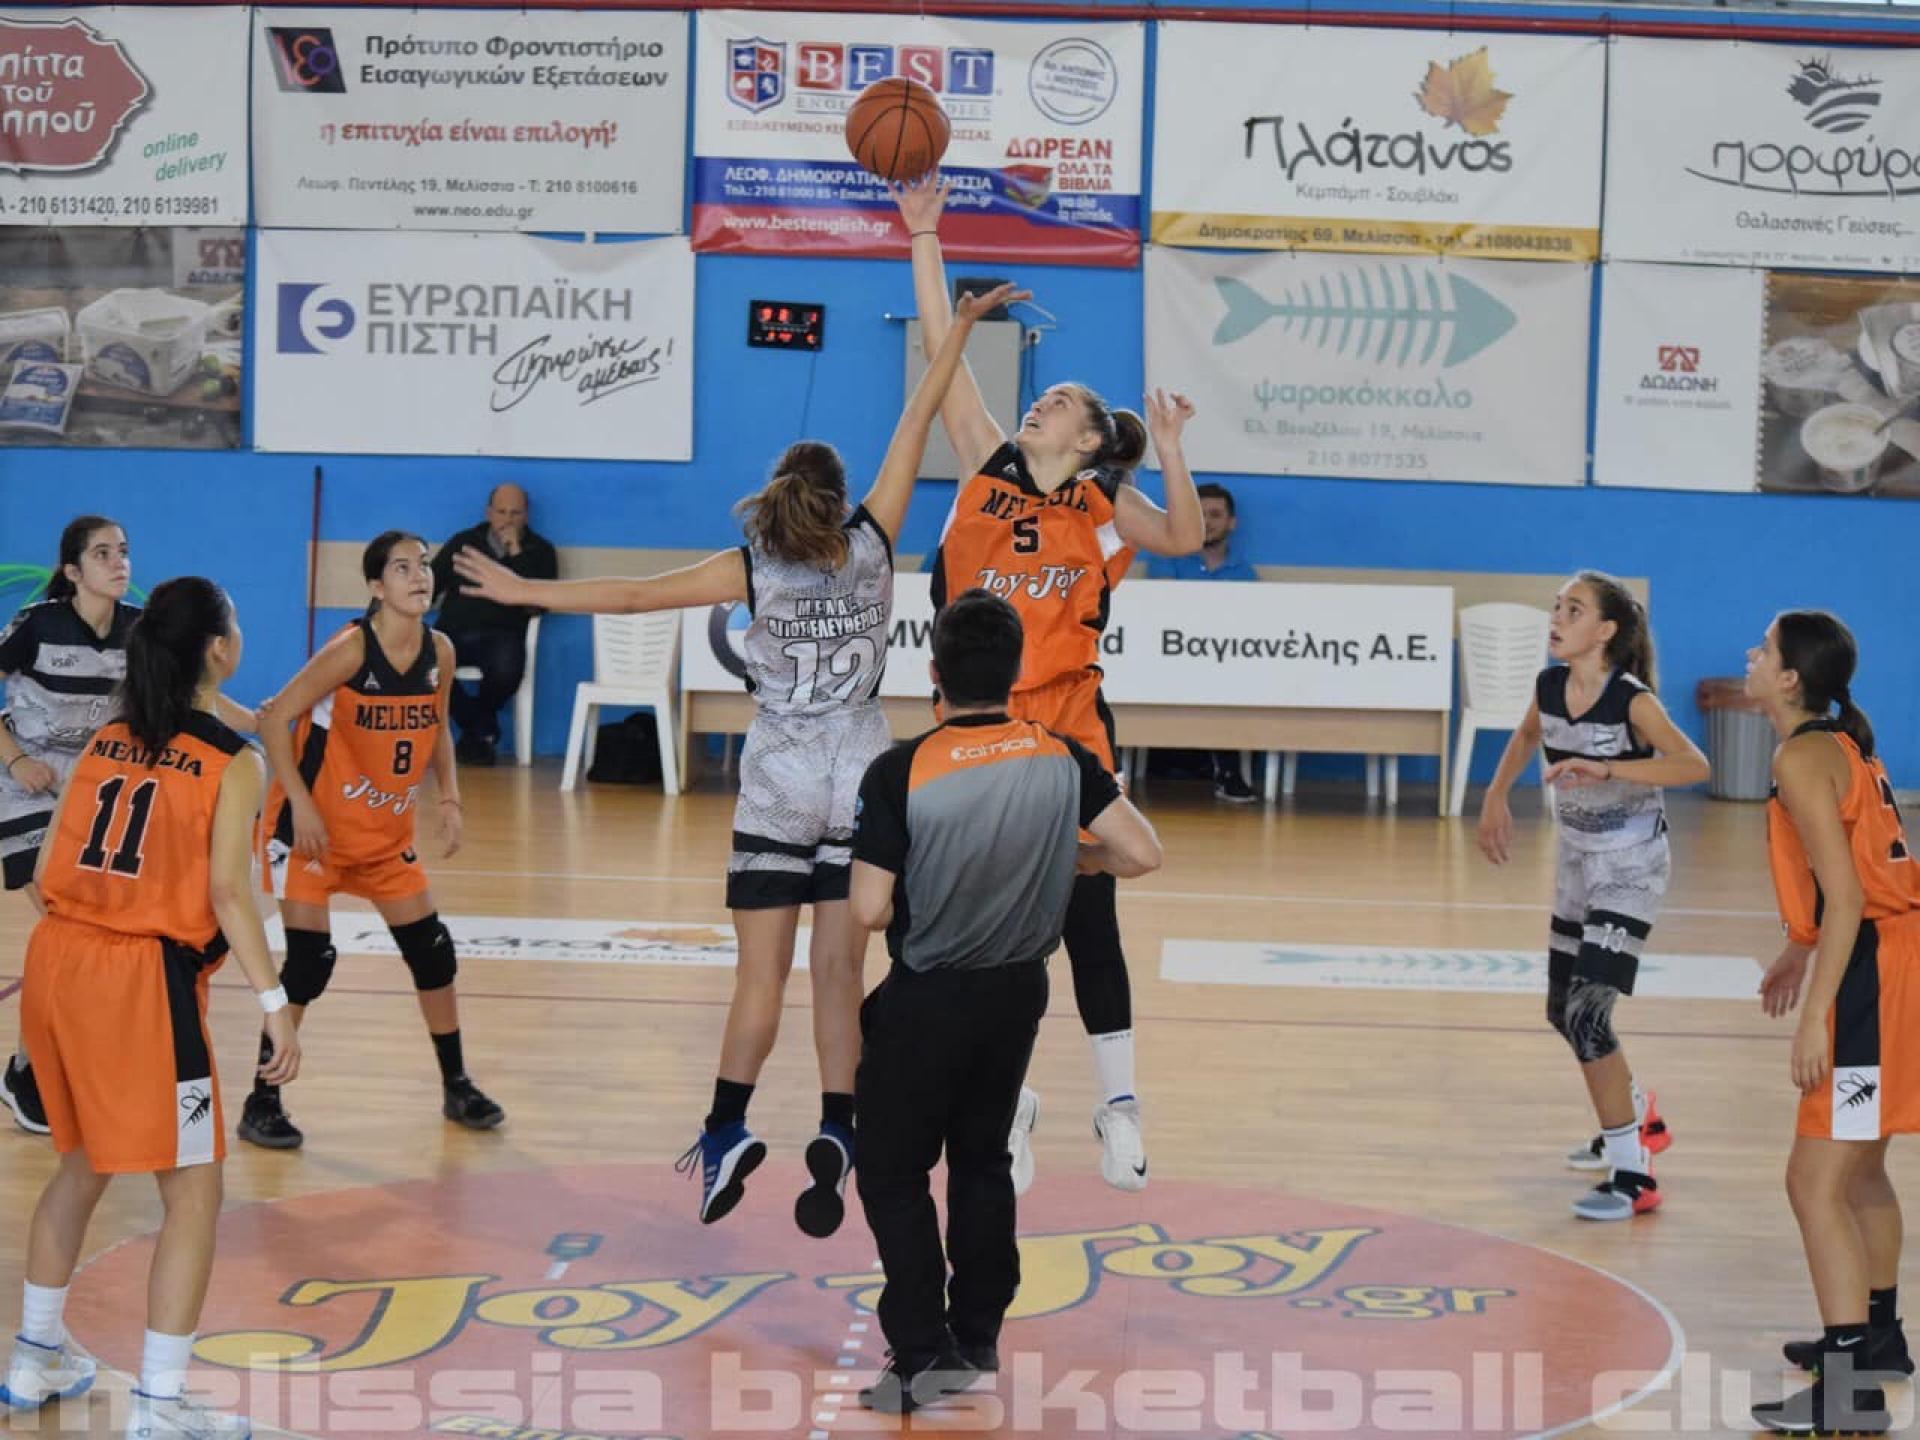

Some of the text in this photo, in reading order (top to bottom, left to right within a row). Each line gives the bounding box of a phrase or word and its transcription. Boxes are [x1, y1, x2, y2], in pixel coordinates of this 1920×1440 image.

[366, 34, 664, 62] Πρότυπο Φροντιστήριο
[360, 64, 668, 89] Εισαγωγικών Εξετάσεων
[802, 46, 990, 92] BEST
[143, 132, 199, 158] online
[342, 119, 443, 148] επιτυχία
[449, 119, 507, 144] είναι
[513, 121, 618, 149] επιλογή!
[1006, 138, 1113, 159] ΔΩΡΕΑΝ
[1243, 117, 1513, 181] Πλάτανος
[155, 152, 228, 182] delivery
[545, 180, 573, 194] 210
[1058, 177, 1112, 191] ΒΙΒΛΙΑ
[21, 196, 46, 214] 210
[123, 197, 149, 214] 210
[724, 214, 893, 236] www.bestenglish.gr
[1735, 210, 1833, 234] Θαλασσινές
[367, 278, 632, 321] ΕΥΡΩΠΑΪΚΗ
[367, 322, 498, 356] ΠΙΣΤΗ
[1253, 377, 1473, 412] ψαροκόκκαλο
[1640, 374, 1717, 392] ΔΩΔΩΝΗ
[1012, 514, 1041, 555] 5
[1162, 628, 1359, 665] Βαγιανέλης
[1369, 633, 1438, 662] Α.Ε.
[781, 635, 877, 704] 12
[392, 738, 415, 777] 8
[76, 774, 160, 879] 11
